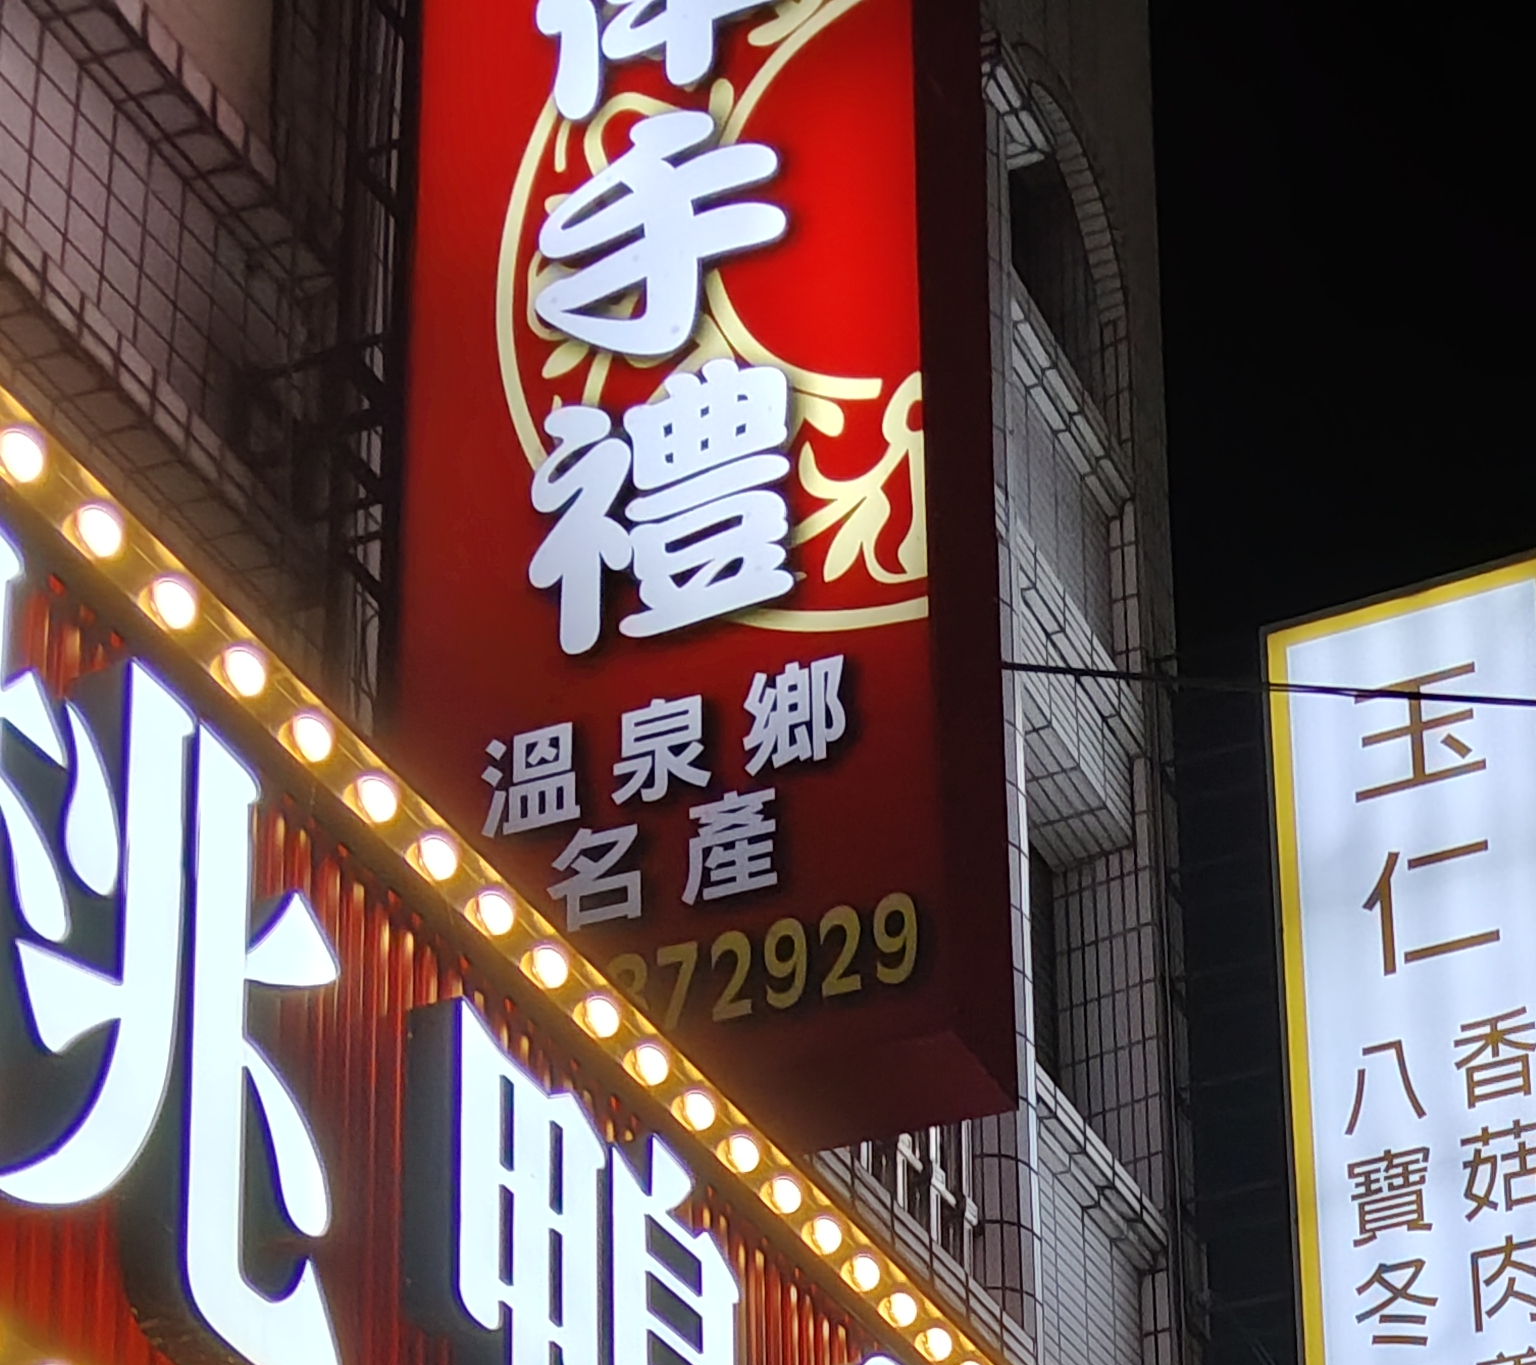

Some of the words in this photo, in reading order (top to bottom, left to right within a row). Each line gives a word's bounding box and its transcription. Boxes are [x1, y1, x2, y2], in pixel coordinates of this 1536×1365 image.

[481, 654, 847, 840] 溫泉鄉
[1354, 661, 1500, 976] 玉仁
[546, 789, 779, 932] 名產
